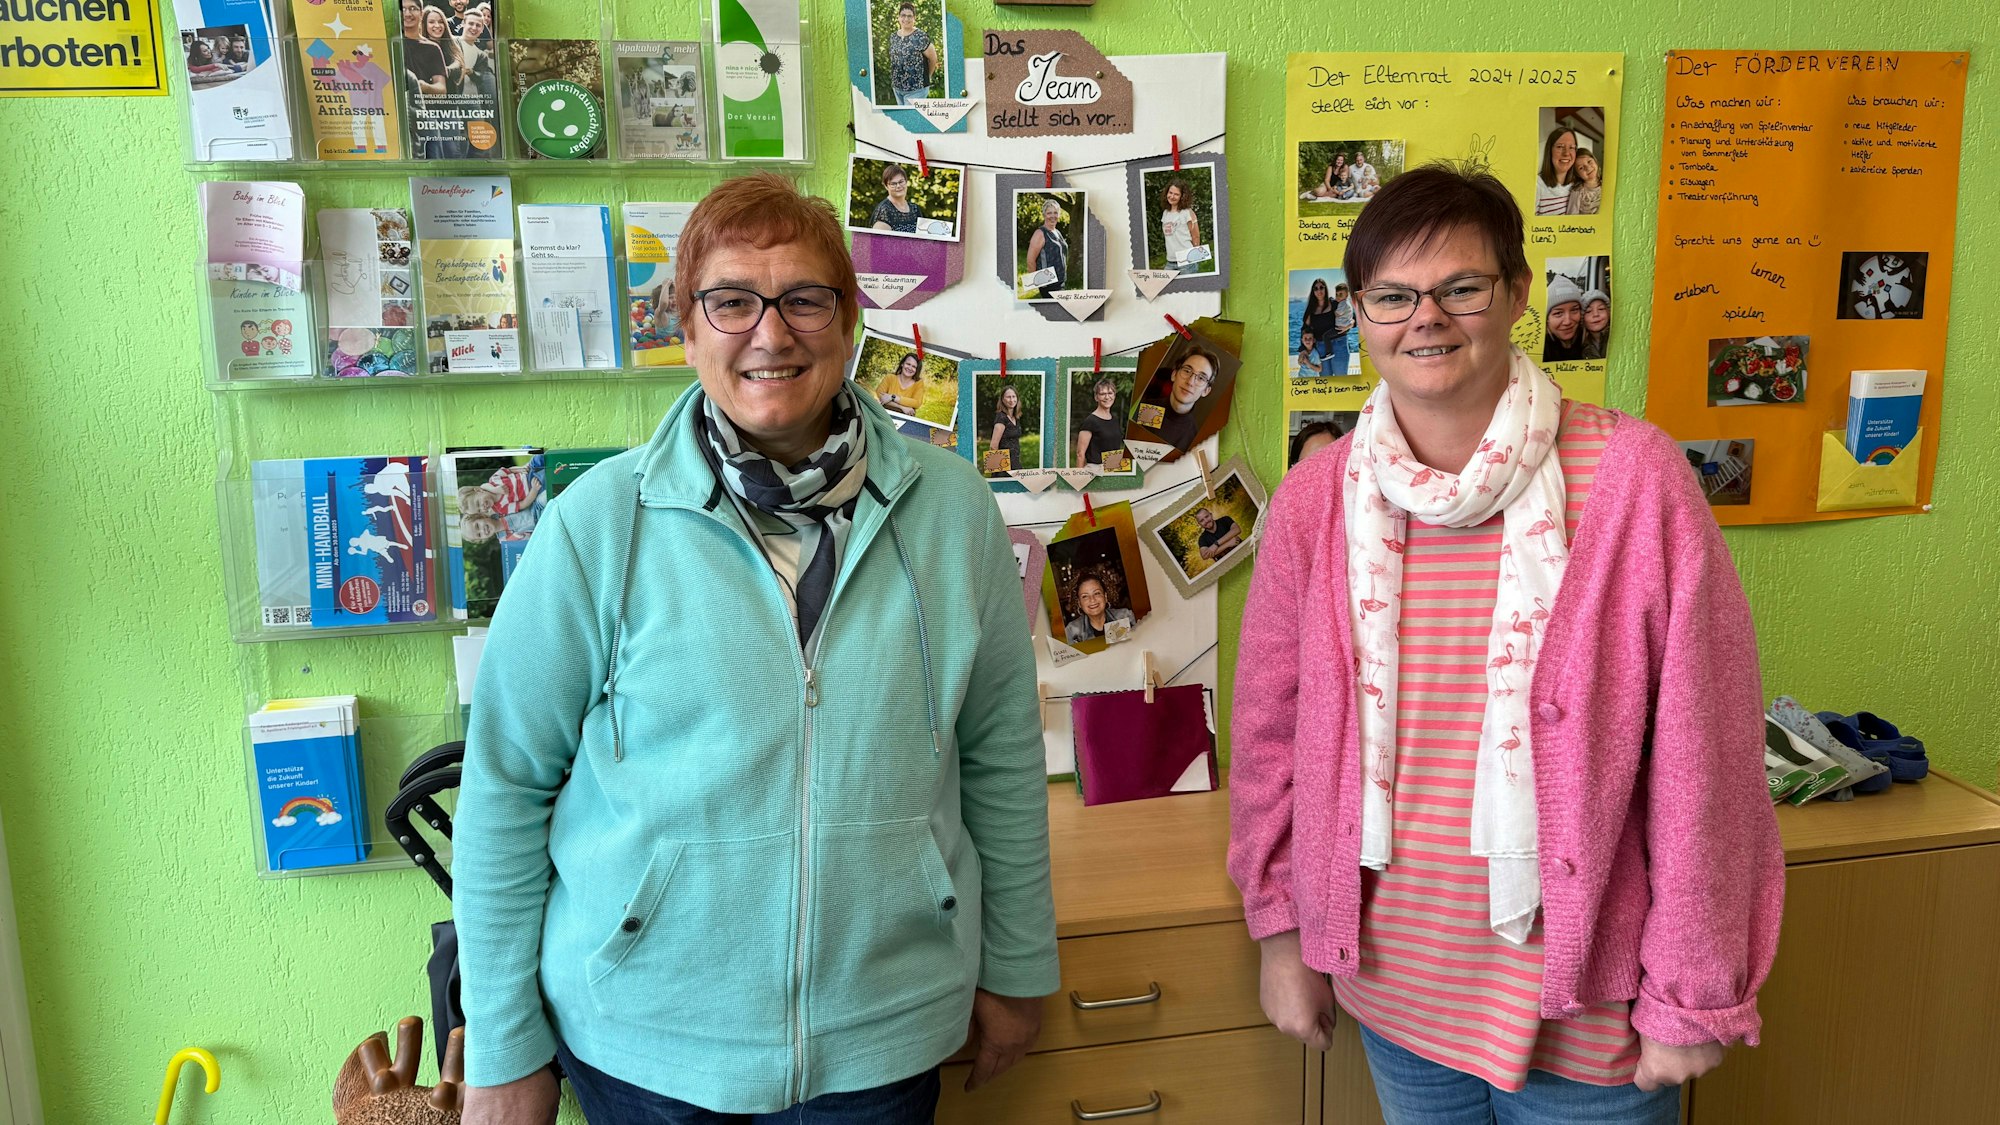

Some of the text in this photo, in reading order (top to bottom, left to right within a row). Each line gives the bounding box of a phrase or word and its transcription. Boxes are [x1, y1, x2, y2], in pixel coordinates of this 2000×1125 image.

[616, 43, 661, 54] Alpakahof
[674, 44, 697, 54] mehr
[984, 33, 1026, 56] Das
[1, 36, 142, 67] rboten!
[1676, 56, 1718, 76] Der
[1019, 52, 1098, 102] Team
[1307, 66, 1350, 88] Der
[1364, 64, 1452, 84] Elternrat
[314, 80, 375, 92] Zukunft
[315, 94, 348, 104] zum
[1311, 98, 1355, 114] stellt
[1365, 96, 1392, 110] sich
[1676, 96, 1705, 109] Was
[1710, 96, 1751, 108] machen
[1848, 94, 1866, 106] Was
[1873, 96, 1918, 108] brauchen
[318, 105, 390, 117] Anfassen.
[416, 110, 494, 118] FREIWILLIGEN
[538, 82, 600, 154] #wirsindunschlagbar
[991, 107, 1127, 130] stellt sich vor...
[416, 121, 465, 130] DIENSTE
[1680, 120, 1735, 135] Anschaffung
[1758, 121, 1813, 132] Spielinventar
[1876, 121, 1918, 134] Mitglieder
[1680, 137, 1712, 149] Planung
[1736, 137, 1794, 151] Unterstützung
[1852, 138, 1938, 148] aktive und motivierte
[1702, 150, 1748, 162] Sommerfest
[1852, 150, 1874, 164] Helfer
[1678, 162, 1719, 172] Tombola
[1850, 166, 1922, 178] zahlreiche Spenden
[1680, 178, 1716, 190] Eiswagen
[232, 190, 254, 205] Baby
[266, 194, 286, 206] Blick
[1298, 220, 1330, 230] Barbara
[1558, 226, 1596, 234] Lüdenbach
[1298, 232, 1329, 242] (Dustin
[1531, 234, 1557, 244] (Leni)
[1674, 234, 1802, 248] Sprecht uns gerne an
[1750, 262, 1786, 288] lernen
[230, 287, 258, 300] Kinder
[882, 284, 904, 292] Leitung
[1674, 284, 1720, 301] erleben
[1722, 306, 1766, 322] spielen
[452, 344, 475, 358] Klick
[312, 492, 334, 590] MINI-HANDBALL
[266, 765, 304, 774] Unterstütze
[278, 773, 304, 781] Zukunft
[268, 779, 318, 790] unserer Kinder!
